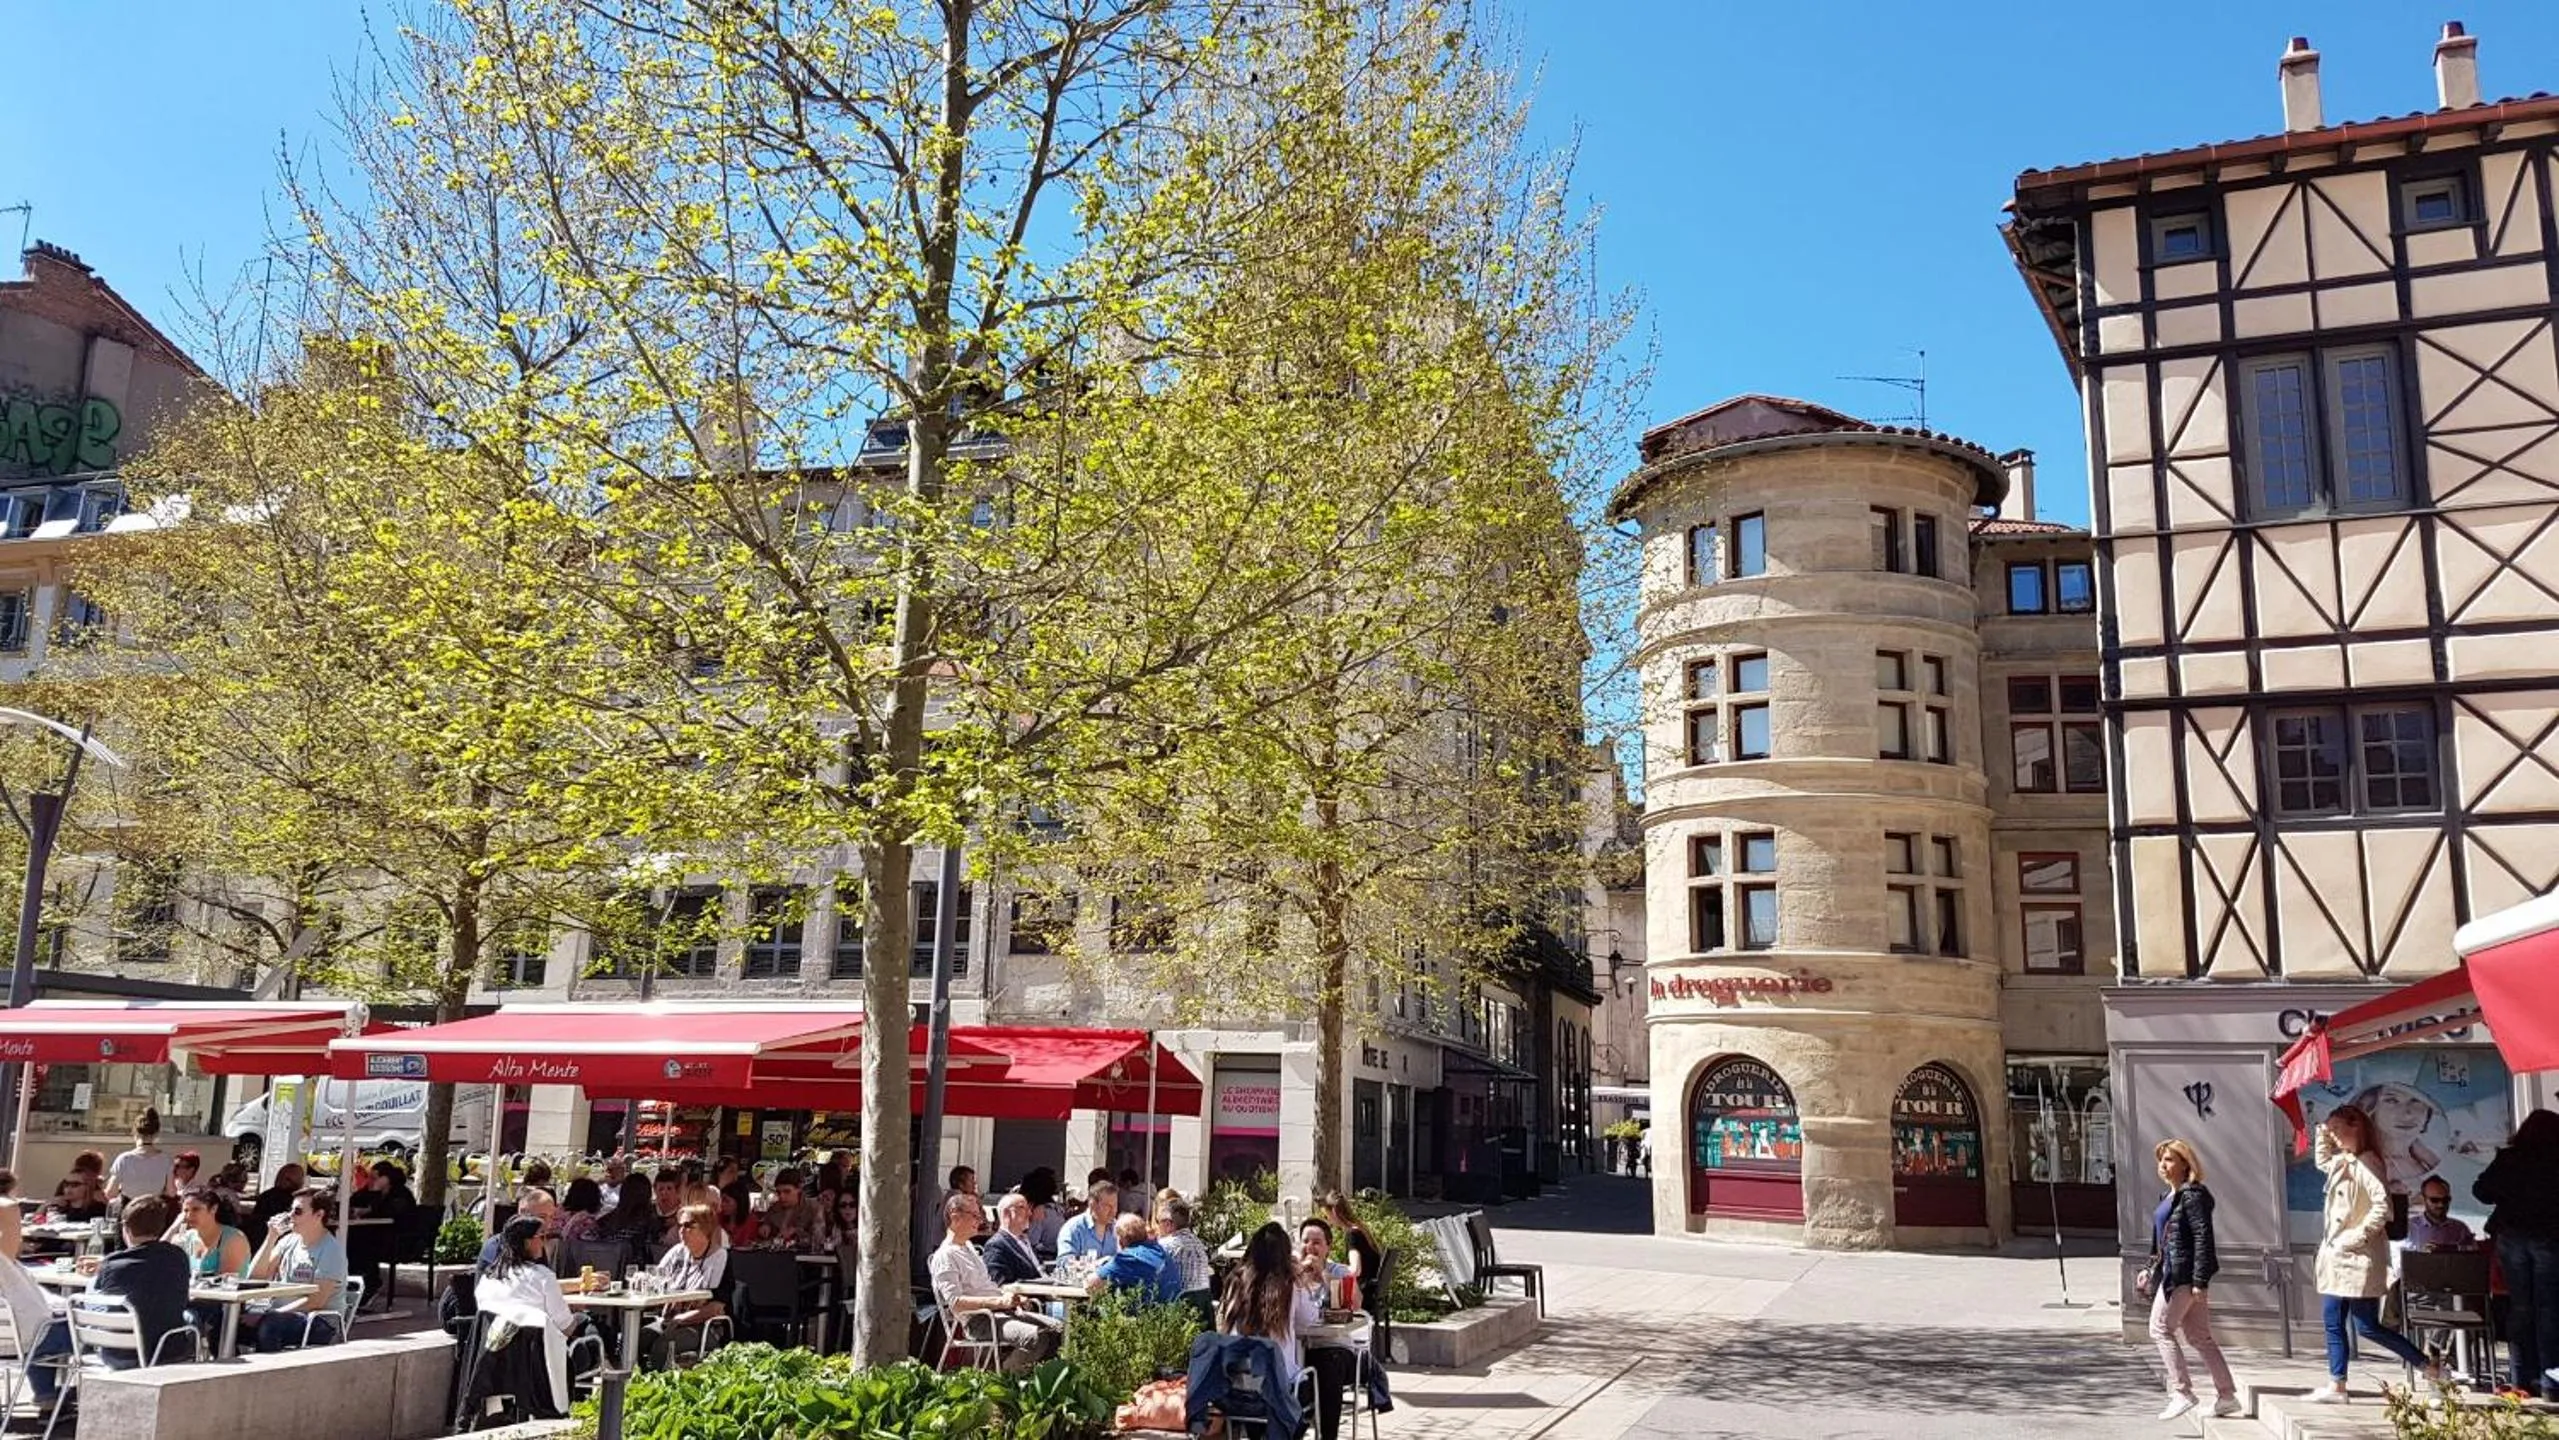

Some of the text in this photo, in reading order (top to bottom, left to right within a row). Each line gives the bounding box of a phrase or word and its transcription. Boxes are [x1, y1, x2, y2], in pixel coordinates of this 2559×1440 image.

[1669, 967, 1833, 1008] droguerie
[488, 1055, 580, 1079] Alta Mente
[1705, 1062, 1786, 1095] DROGUERIE
[1705, 1092, 1786, 1108] TOUR
[1895, 1098, 1965, 1115] TOUR
